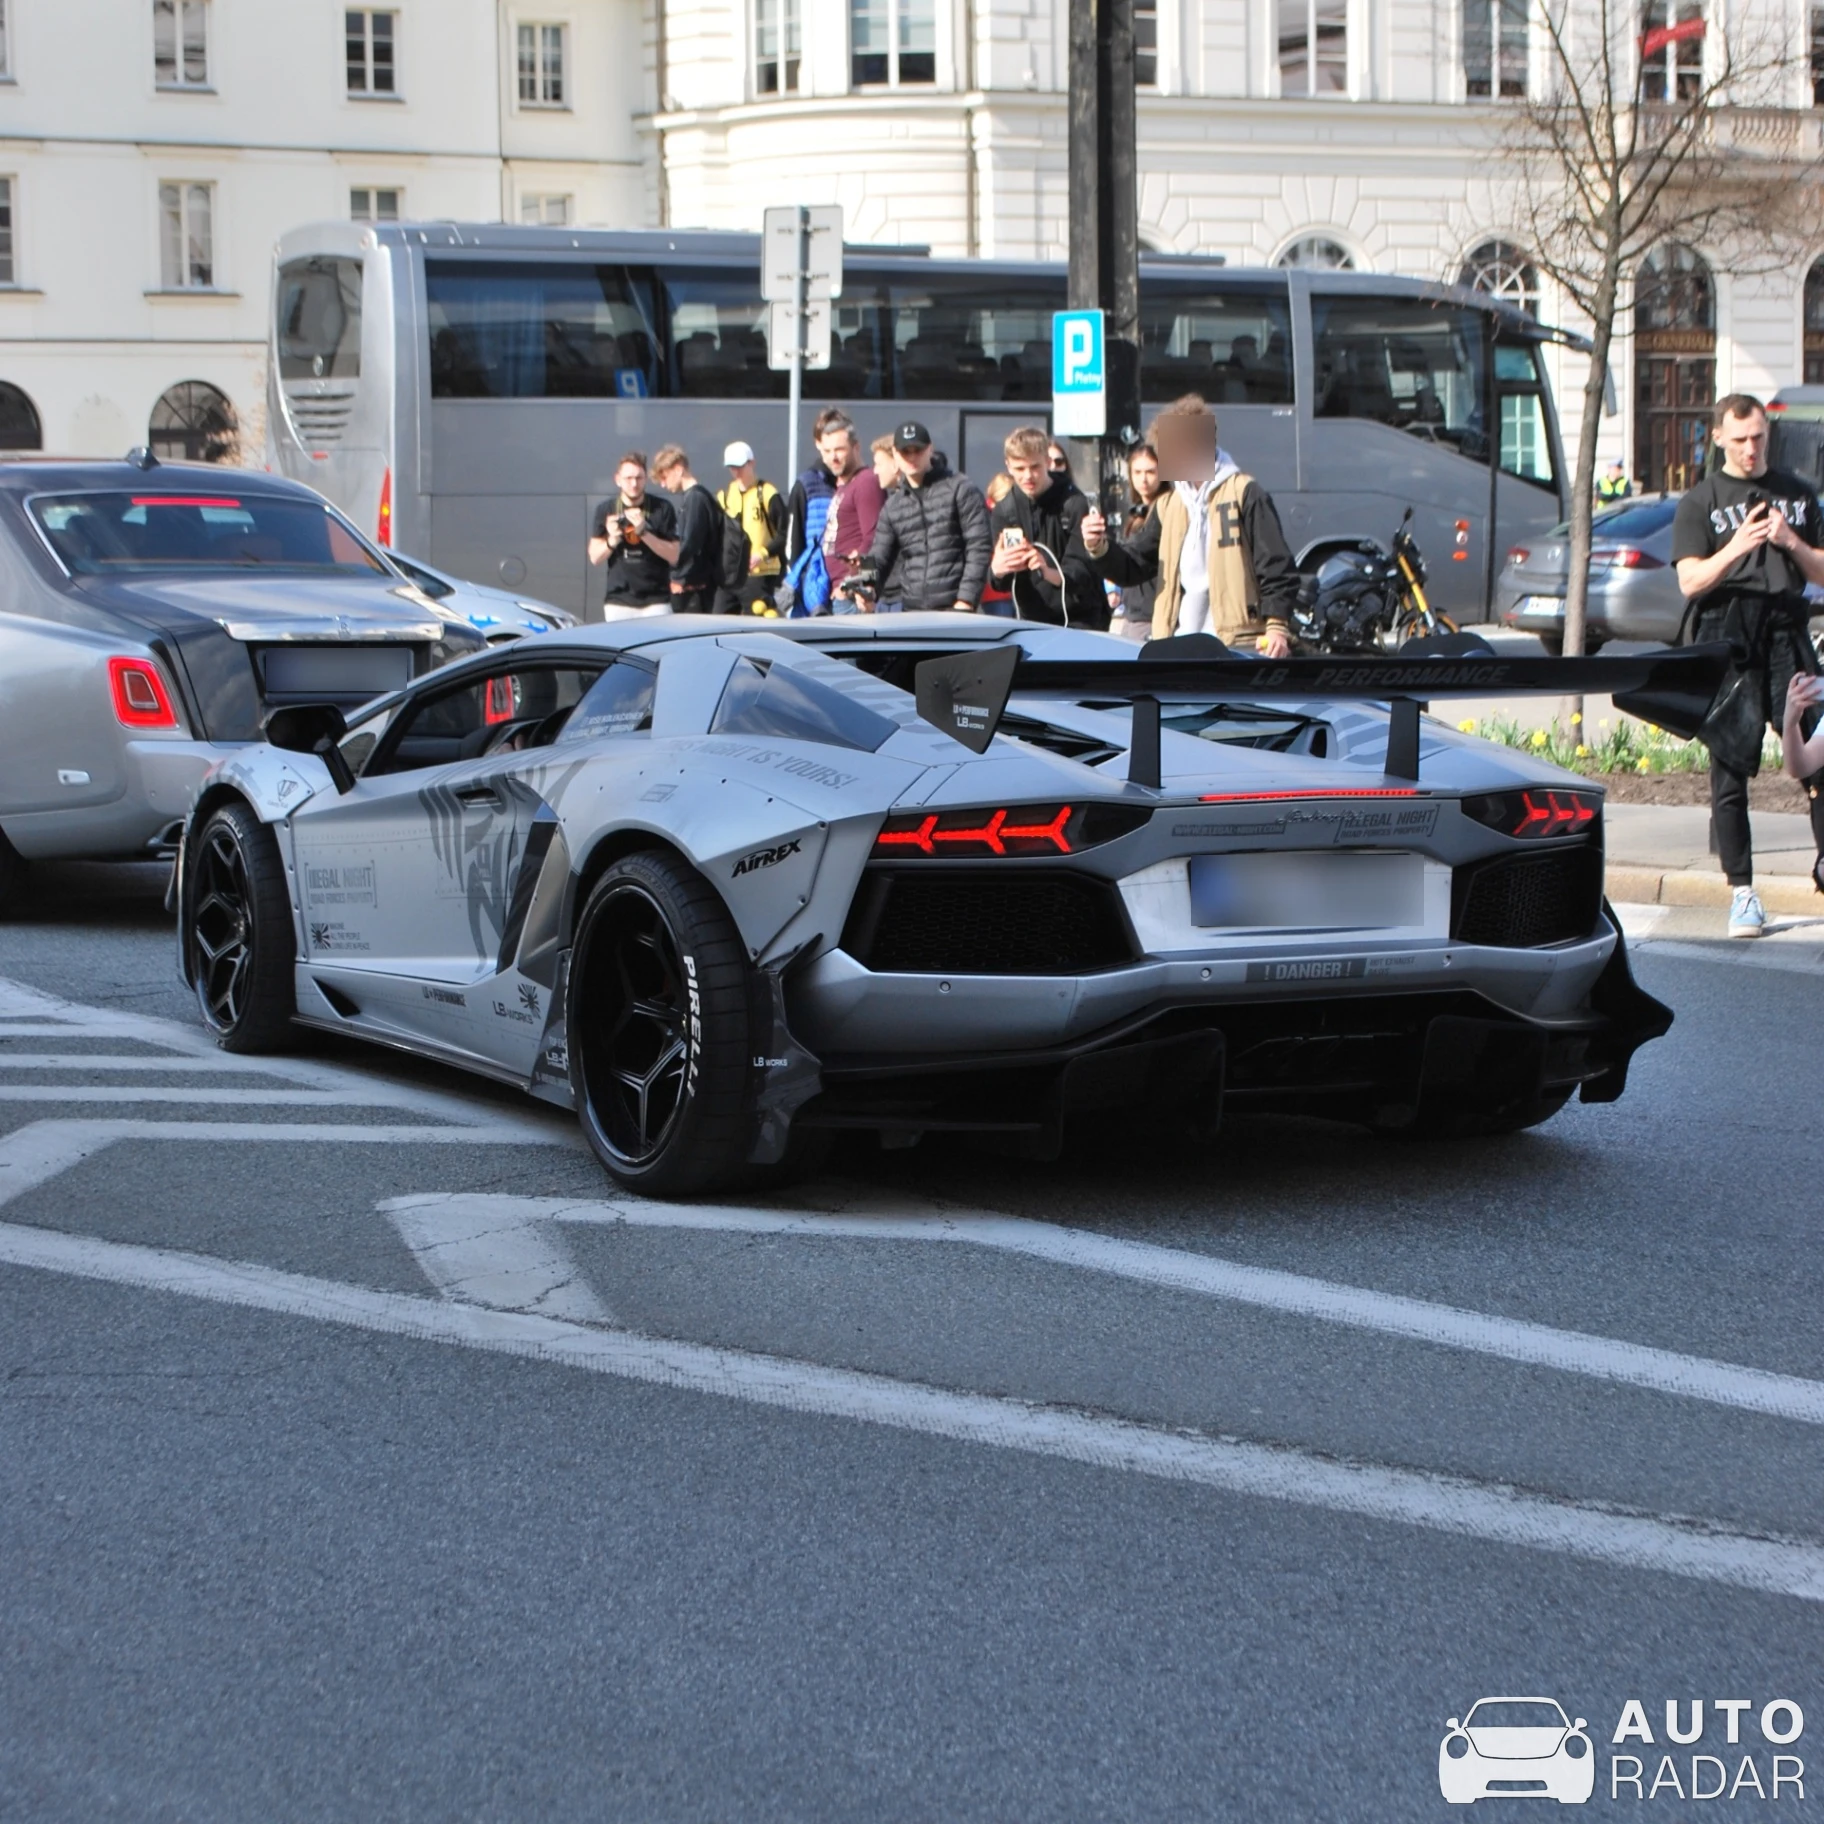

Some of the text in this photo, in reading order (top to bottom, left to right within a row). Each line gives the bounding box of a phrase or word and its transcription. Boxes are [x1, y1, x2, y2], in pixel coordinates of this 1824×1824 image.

[1064, 319, 1093, 385] P
[1250, 665, 1510, 687] LB PERFORMANCE
[747, 747, 781, 764] IS
[774, 756, 858, 790] YOURS!
[1396, 809, 1435, 824] NIGHT
[343, 867, 371, 888] NIGHT
[1275, 962, 1341, 980] DANGER
[683, 955, 702, 1098] PIRELLI
[753, 1056, 788, 1067] LB WORKS
